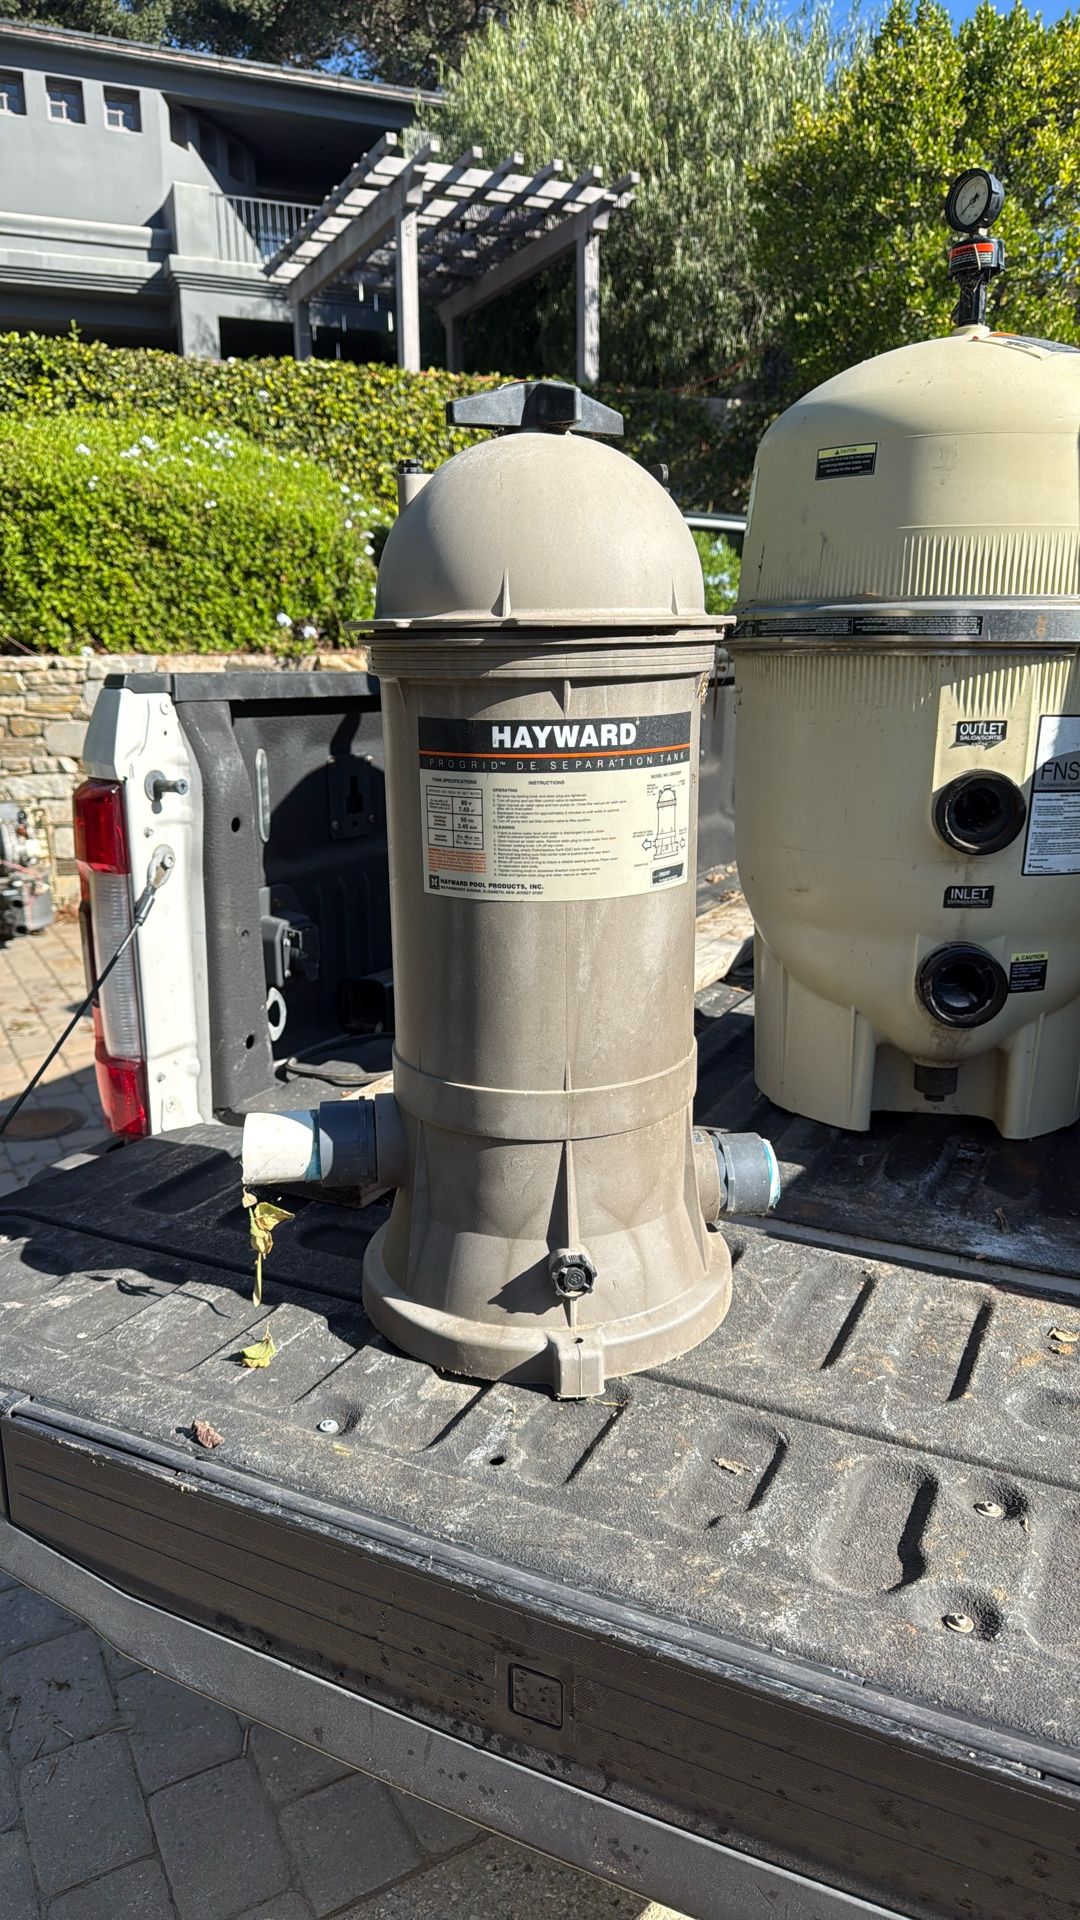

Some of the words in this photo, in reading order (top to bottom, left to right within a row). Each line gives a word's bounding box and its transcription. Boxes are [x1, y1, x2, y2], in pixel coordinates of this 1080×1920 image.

[492, 722, 636, 748] HAYWARD
[960, 722, 1004, 735] OUTLET
[550, 756, 653, 770] SEPARATION
[660, 751, 684, 763] TANK
[1041, 761, 1080, 780] FNS
[440, 878, 468, 887] HAYWARD
[950, 888, 989, 900] INLET
